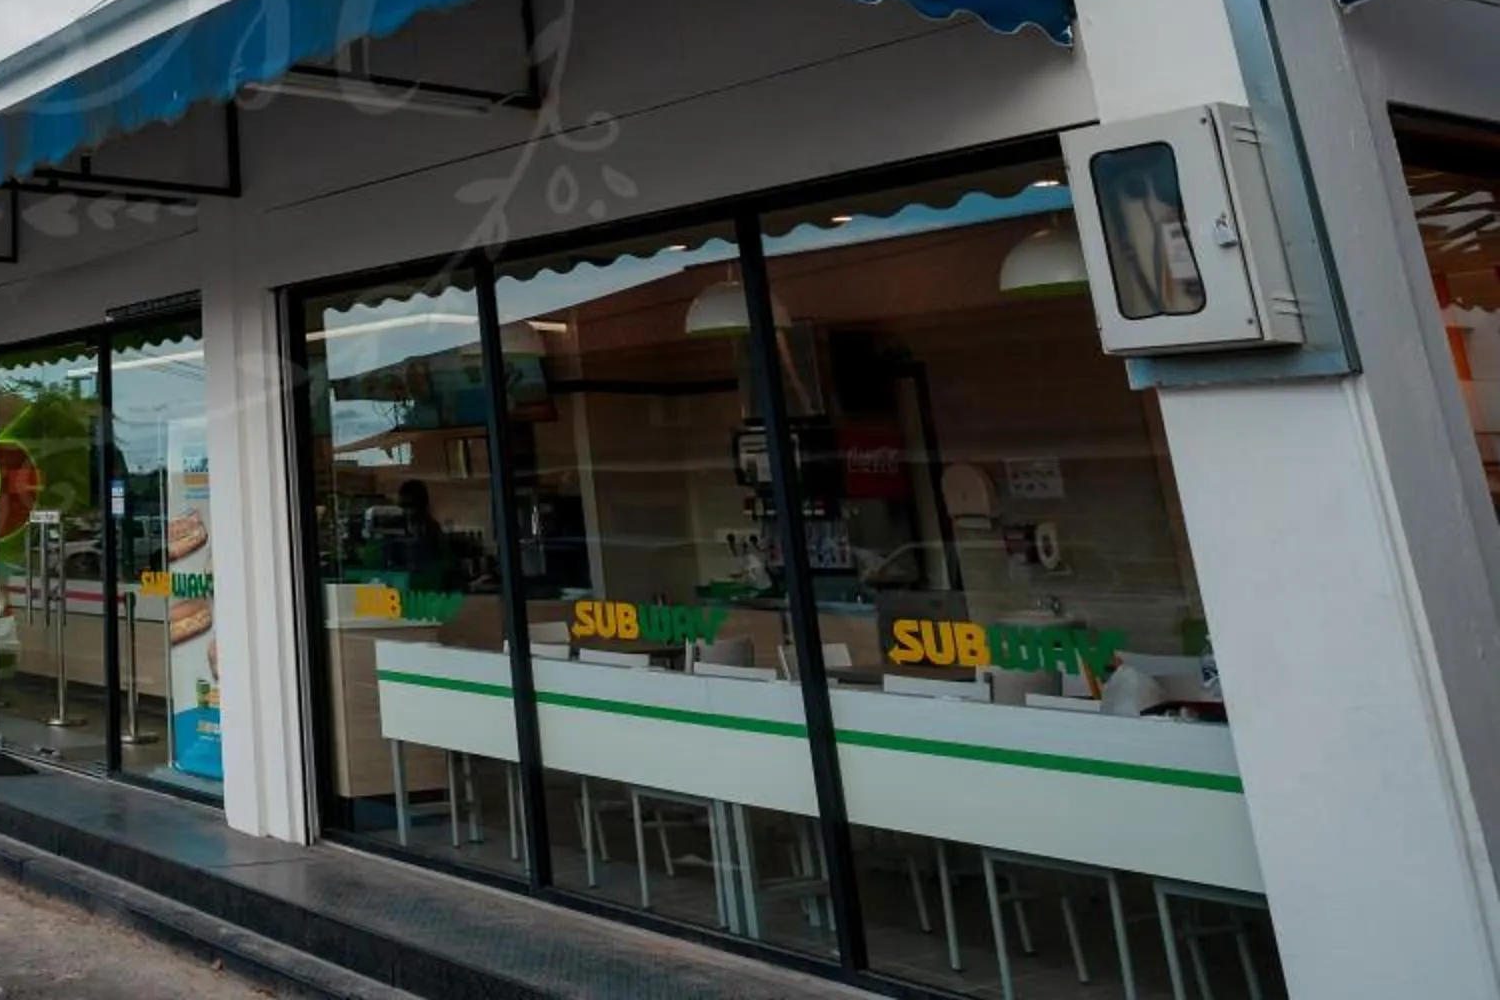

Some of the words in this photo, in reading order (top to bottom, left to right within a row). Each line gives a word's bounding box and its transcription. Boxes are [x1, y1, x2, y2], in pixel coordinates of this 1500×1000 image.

[354, 586, 467, 624] SUBWAY
[571, 599, 731, 646] SUBWAY
[888, 618, 1128, 680] SUBWAY
